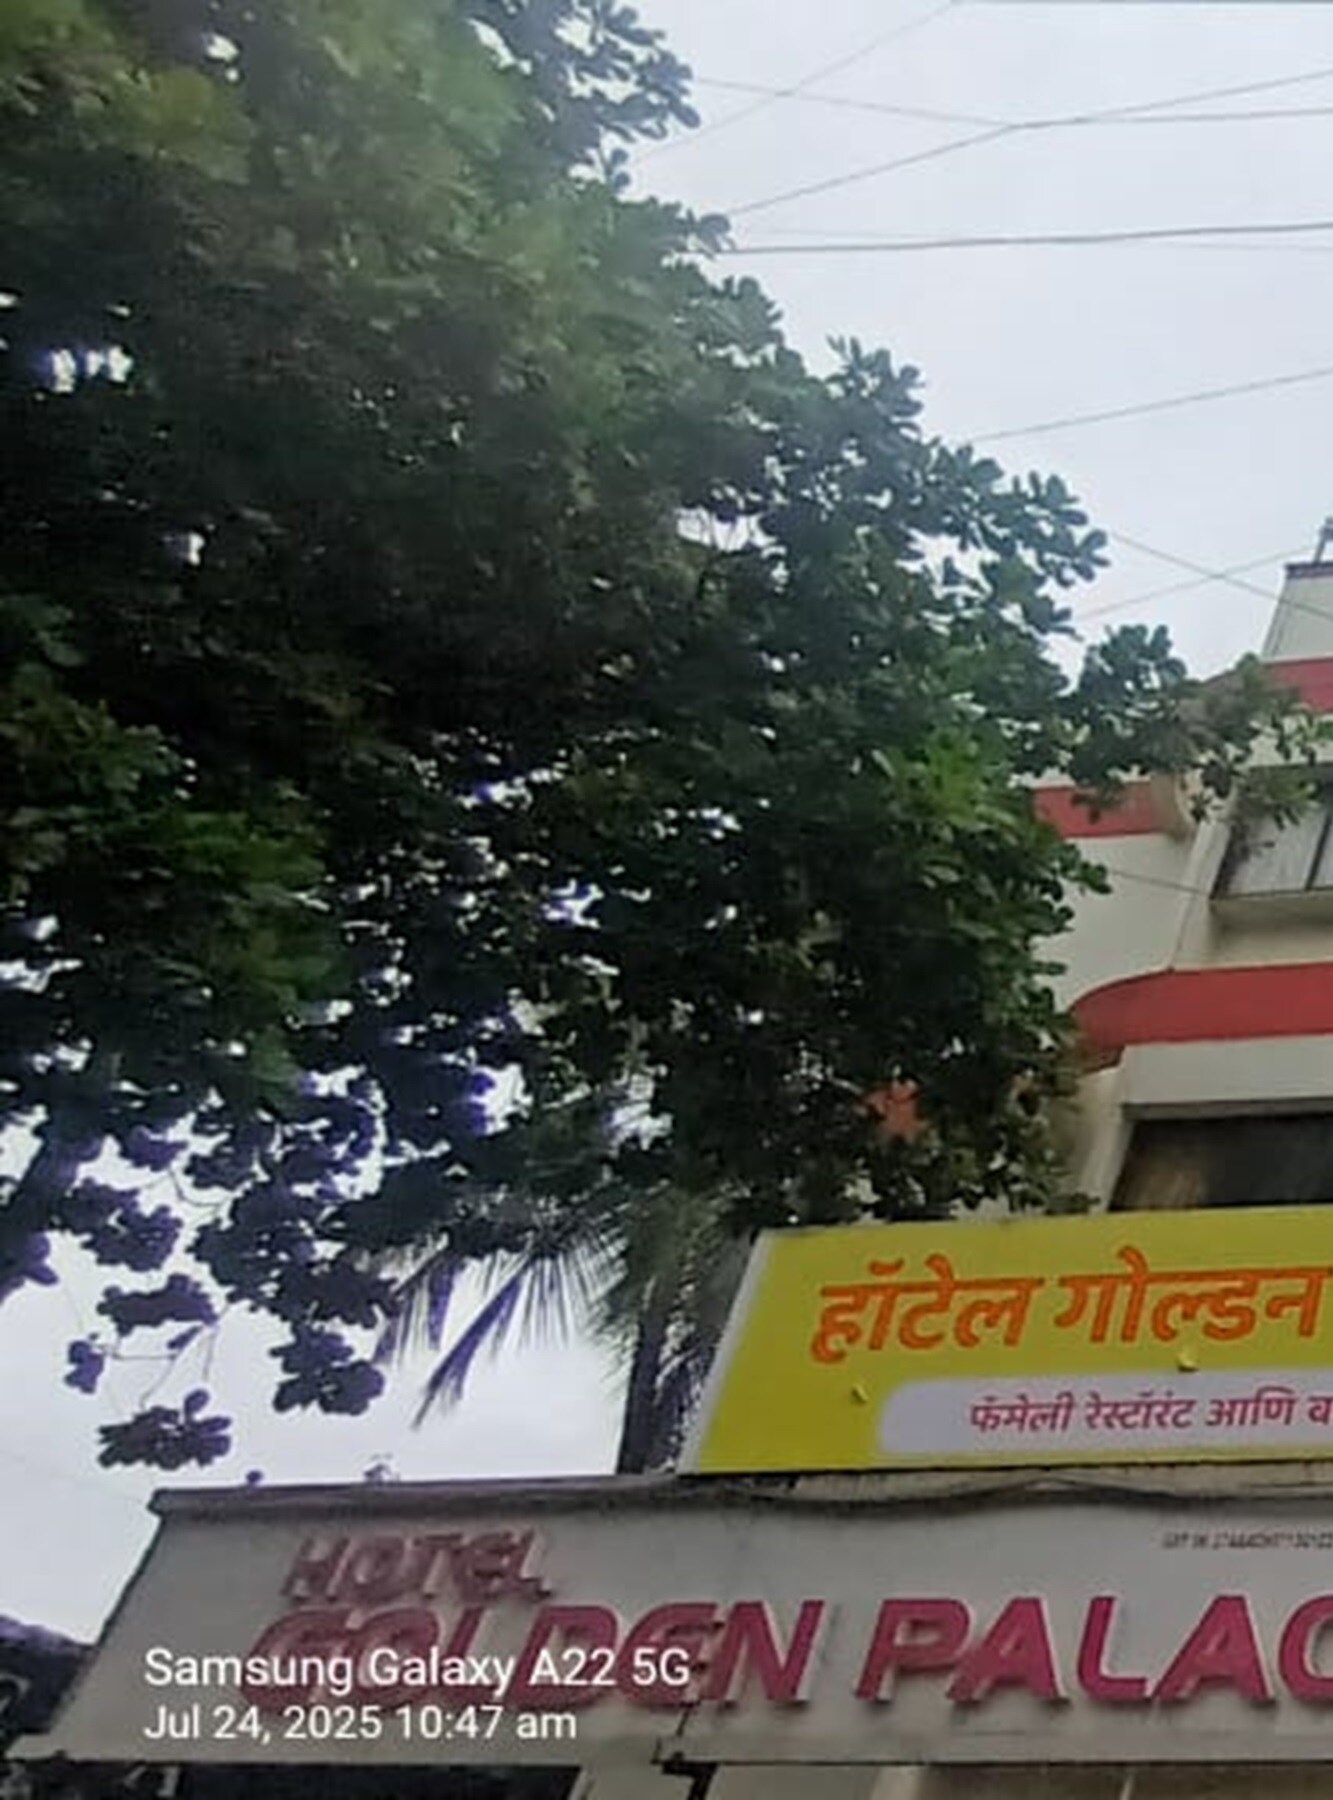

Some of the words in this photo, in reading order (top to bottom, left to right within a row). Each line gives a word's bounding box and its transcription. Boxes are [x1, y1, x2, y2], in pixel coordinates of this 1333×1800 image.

[810, 1255, 1044, 1364] हॉटेल
[1205, 1384, 1298, 1427] आणि
[283, 1529, 554, 1600] HOTEL
[240, 1599, 826, 1712] GOLDEN
